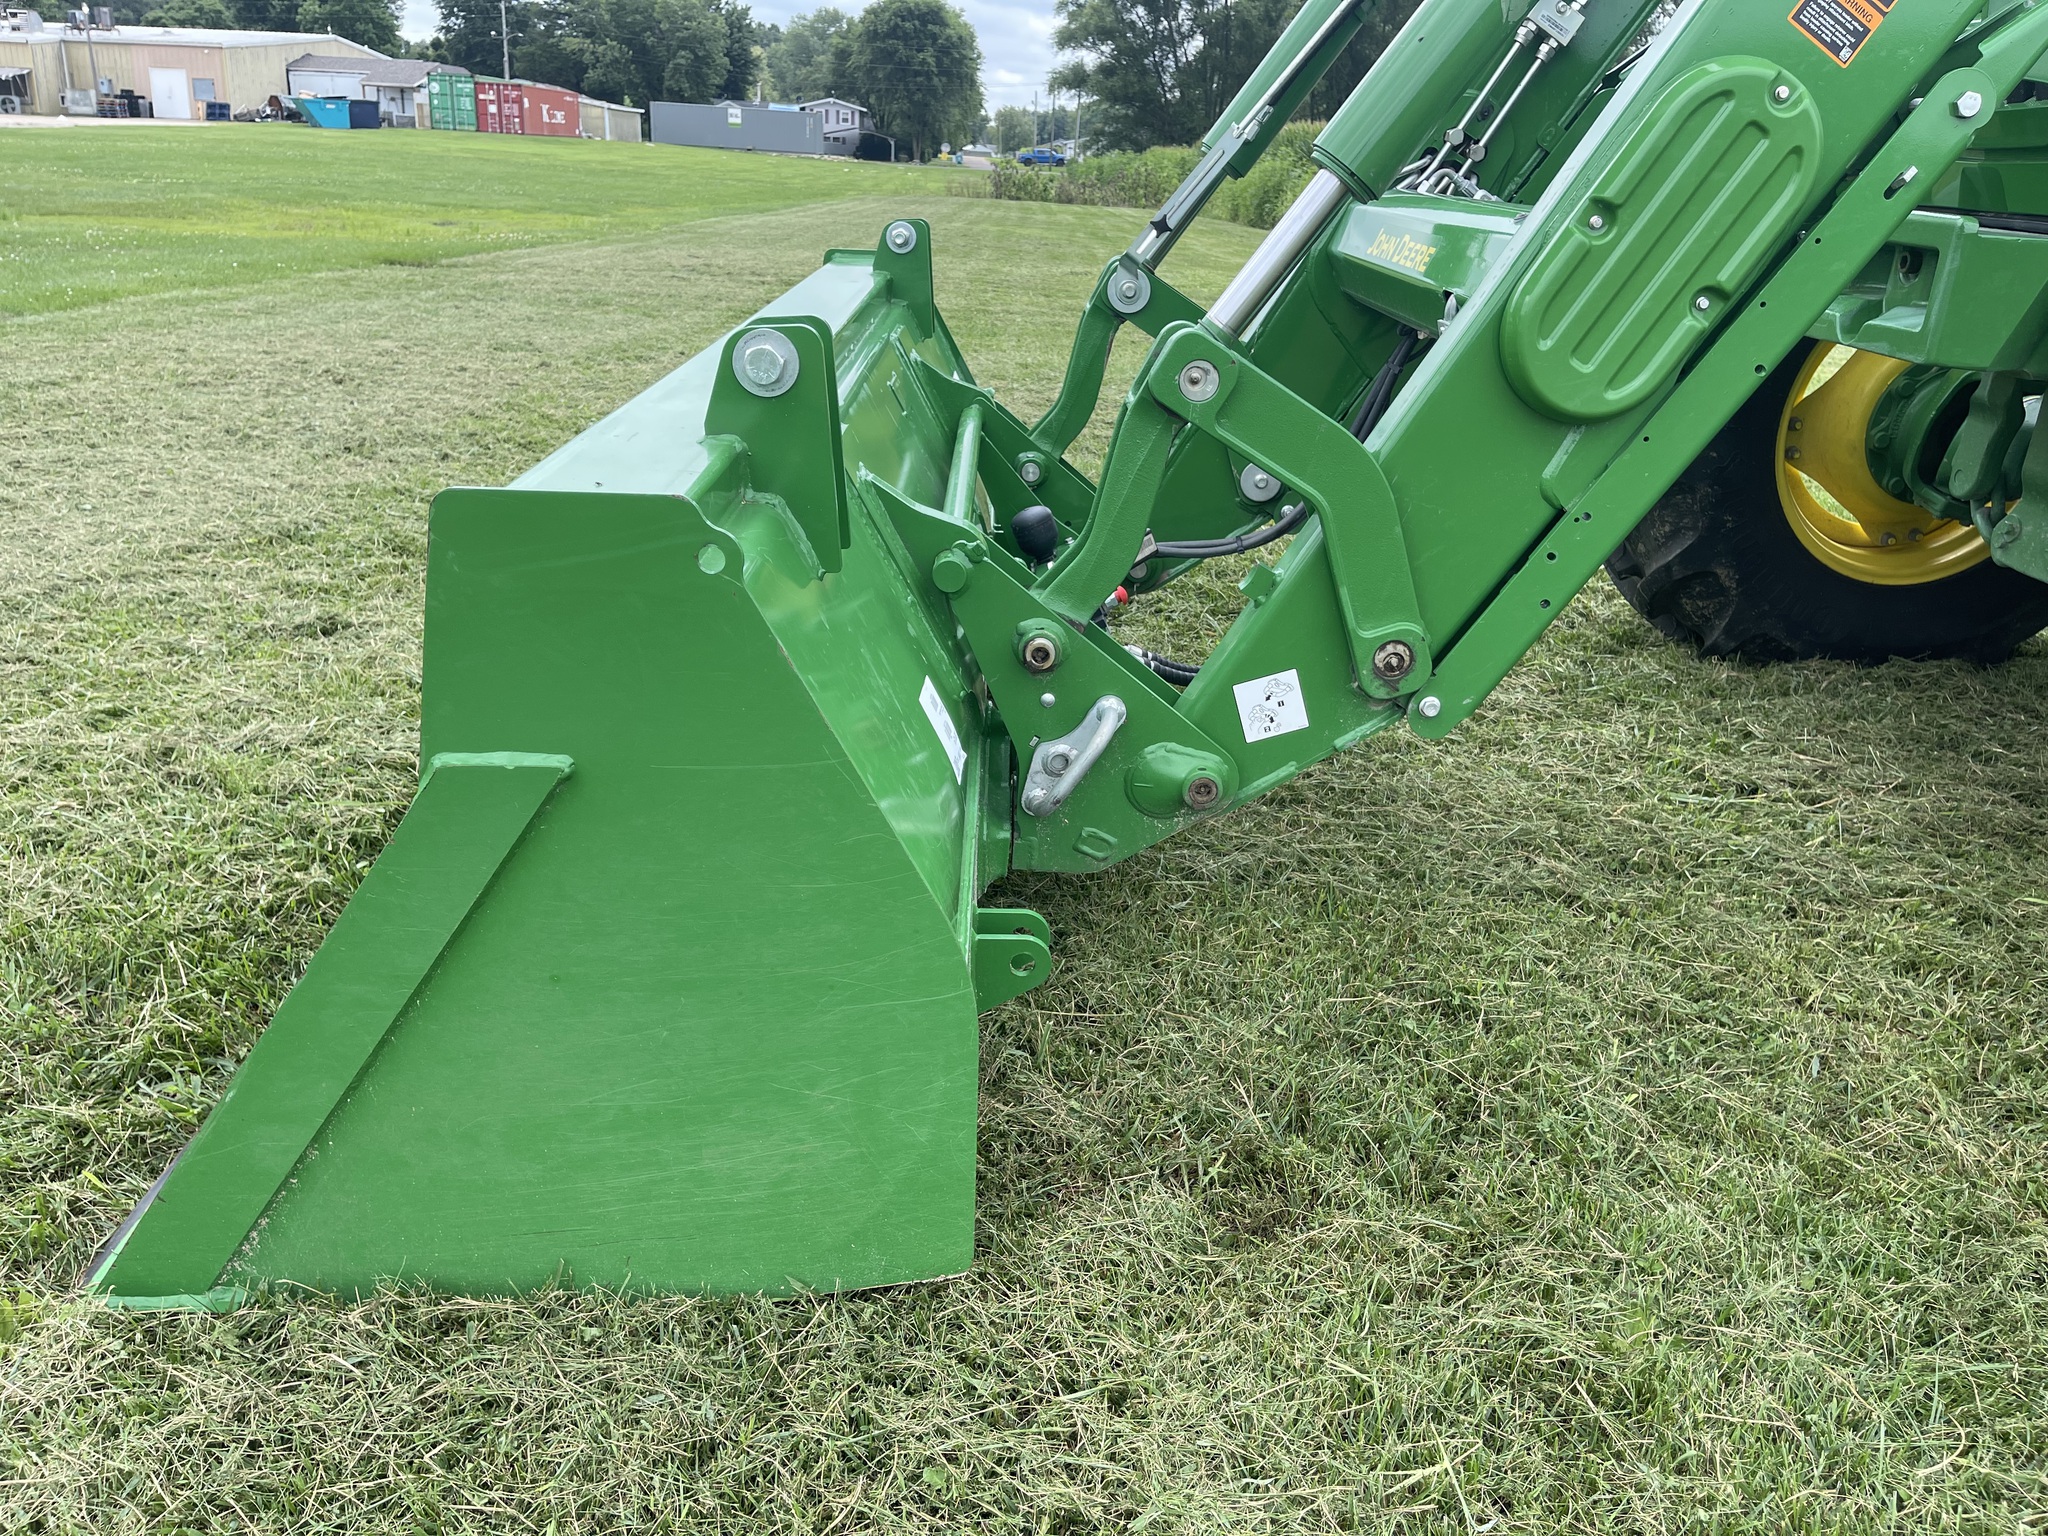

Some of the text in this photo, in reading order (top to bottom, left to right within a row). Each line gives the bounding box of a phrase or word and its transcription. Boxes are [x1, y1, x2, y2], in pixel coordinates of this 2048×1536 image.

[1845, 0, 1873, 23] RNING
[1366, 228, 1436, 272] JOHN DEERE
